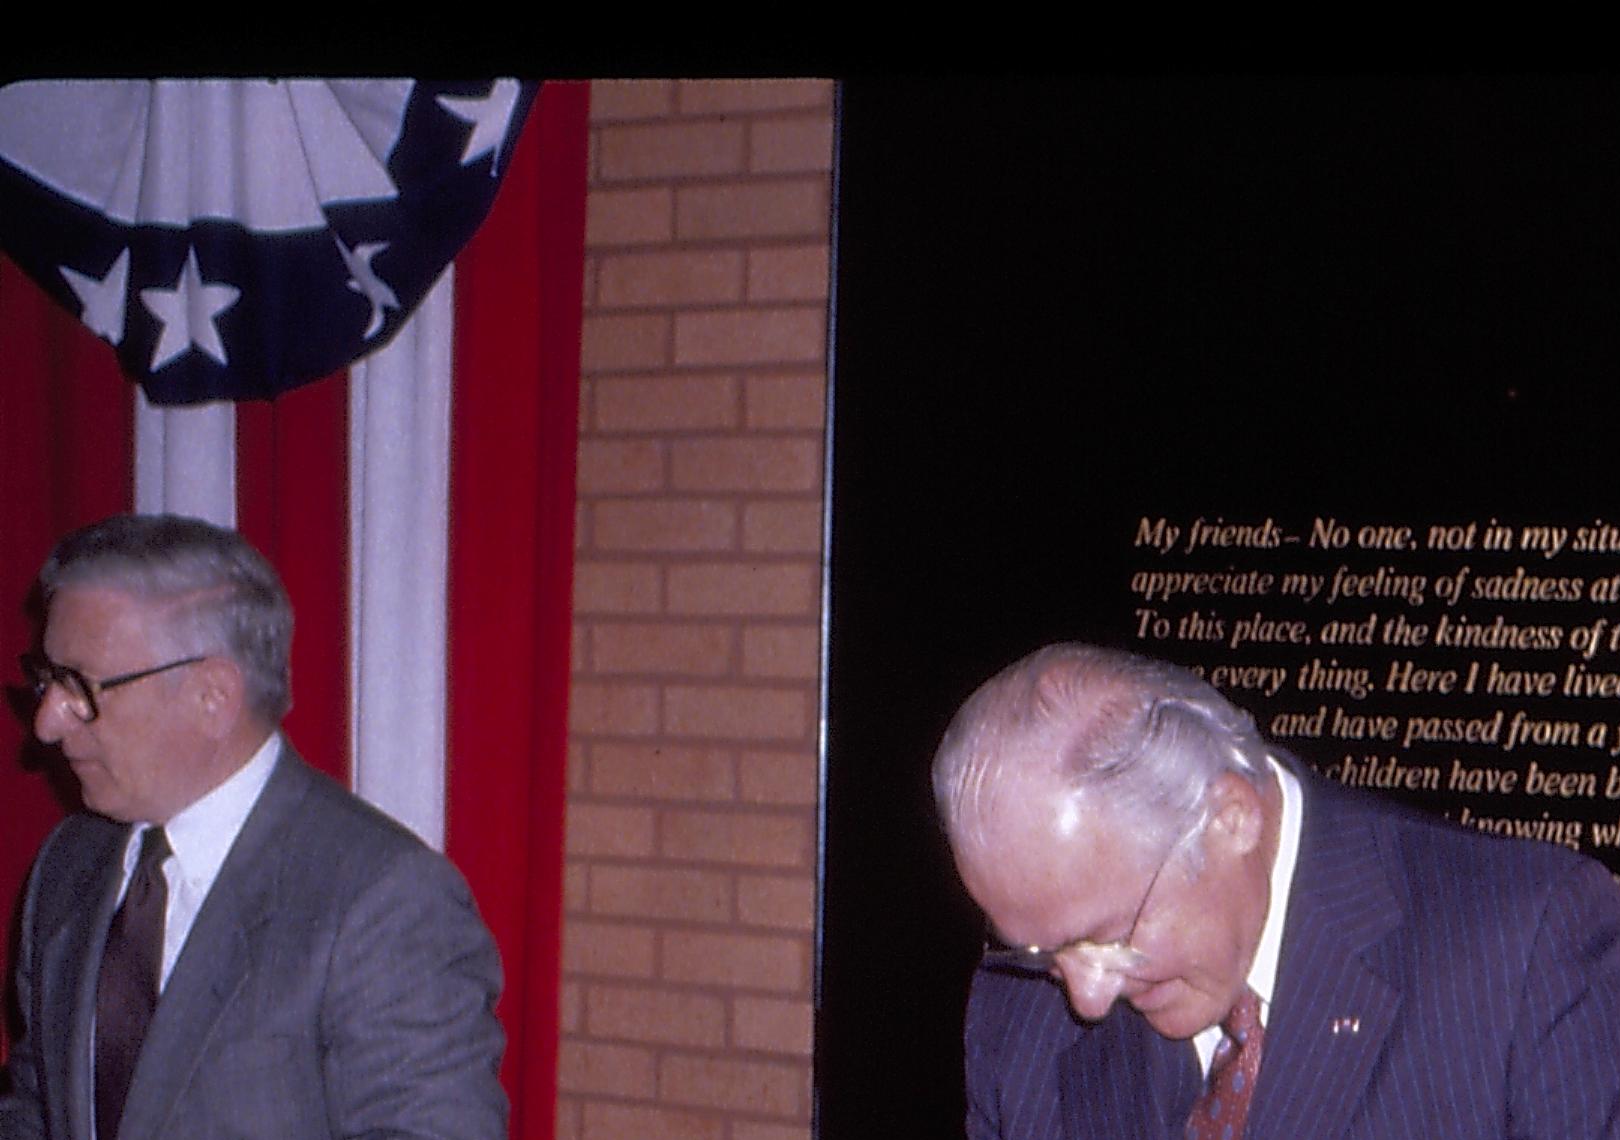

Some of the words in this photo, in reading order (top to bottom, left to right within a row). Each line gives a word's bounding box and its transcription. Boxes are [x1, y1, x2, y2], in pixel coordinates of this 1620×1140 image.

[1134, 517, 1179, 553] My
[1309, 517, 1350, 548] No
[1427, 523, 1477, 549] not
[1483, 518, 1512, 549] in
[1520, 526, 1567, 558] my
[1131, 566, 1273, 600] appreciate
[1281, 573, 1324, 601] my
[1327, 565, 1426, 604] feeling
[1434, 565, 1471, 605] of
[1470, 566, 1584, 601] sadness
[1134, 608, 1170, 639] To
[1178, 611, 1224, 640] this
[1320, 613, 1378, 643] and
[1382, 615, 1428, 645] the
[1435, 614, 1563, 649] kindness
[1569, 617, 1608, 660] of
[1211, 665, 1286, 697] every
[1386, 660, 1457, 693] Here
[1464, 661, 1479, 693] I
[1486, 662, 1556, 695] have
[1271, 705, 1326, 736] and
[1331, 707, 1398, 738] have
[1403, 710, 1503, 747] passed
[1503, 711, 1579, 750] from
[1586, 723, 1607, 747] a
[1449, 759, 1517, 792] have
[1525, 761, 1596, 798] been
